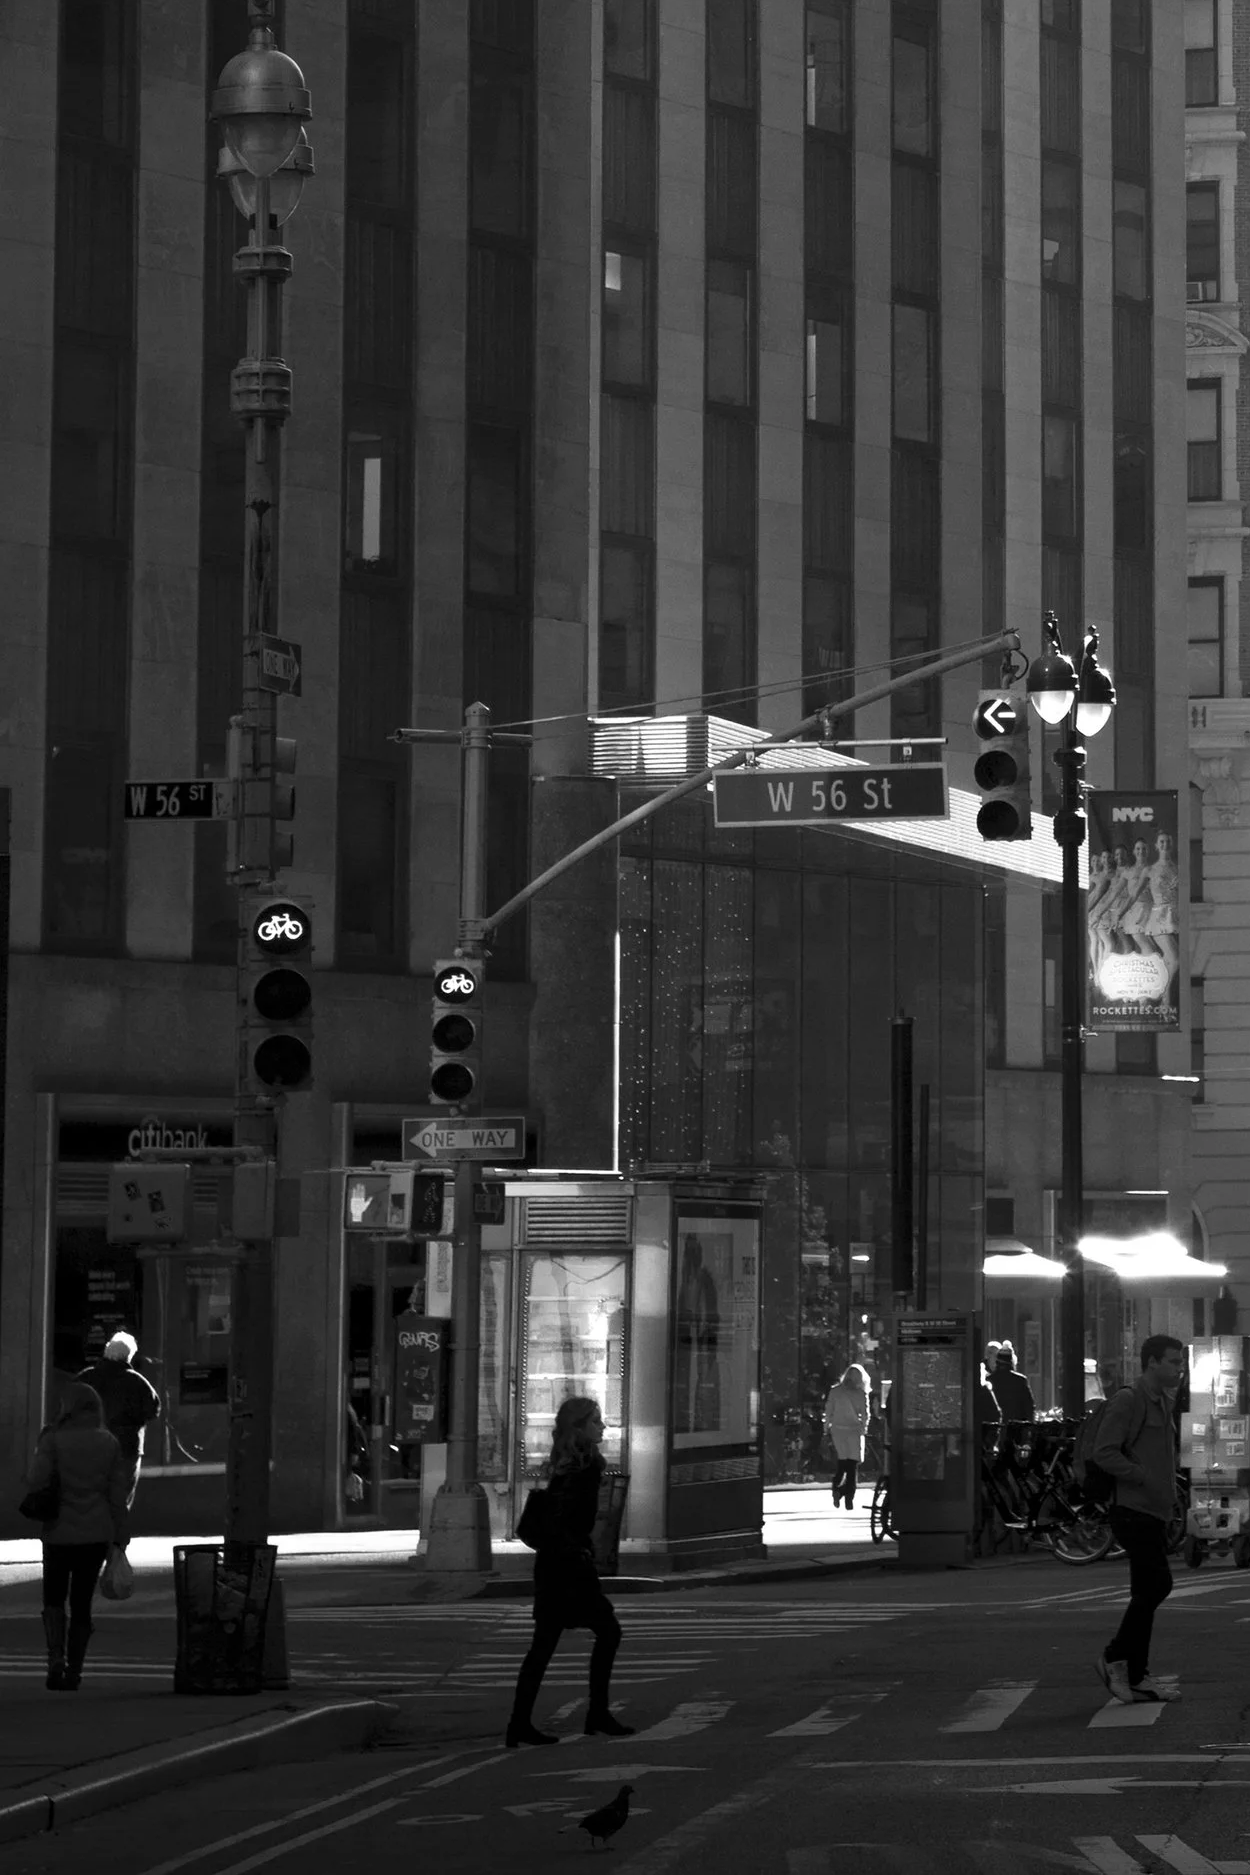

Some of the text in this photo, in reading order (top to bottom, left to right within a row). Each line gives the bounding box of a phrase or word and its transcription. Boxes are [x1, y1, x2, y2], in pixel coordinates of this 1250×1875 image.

[130, 784, 206, 817] W 56 ST
[767, 778, 893, 813] W 56 St
[1112, 807, 1154, 822] NYC
[1093, 1006, 1178, 1015] ROCKETTES.COM
[128, 1119, 208, 1157] citibank
[422, 1130, 508, 1148] ONE WAY
